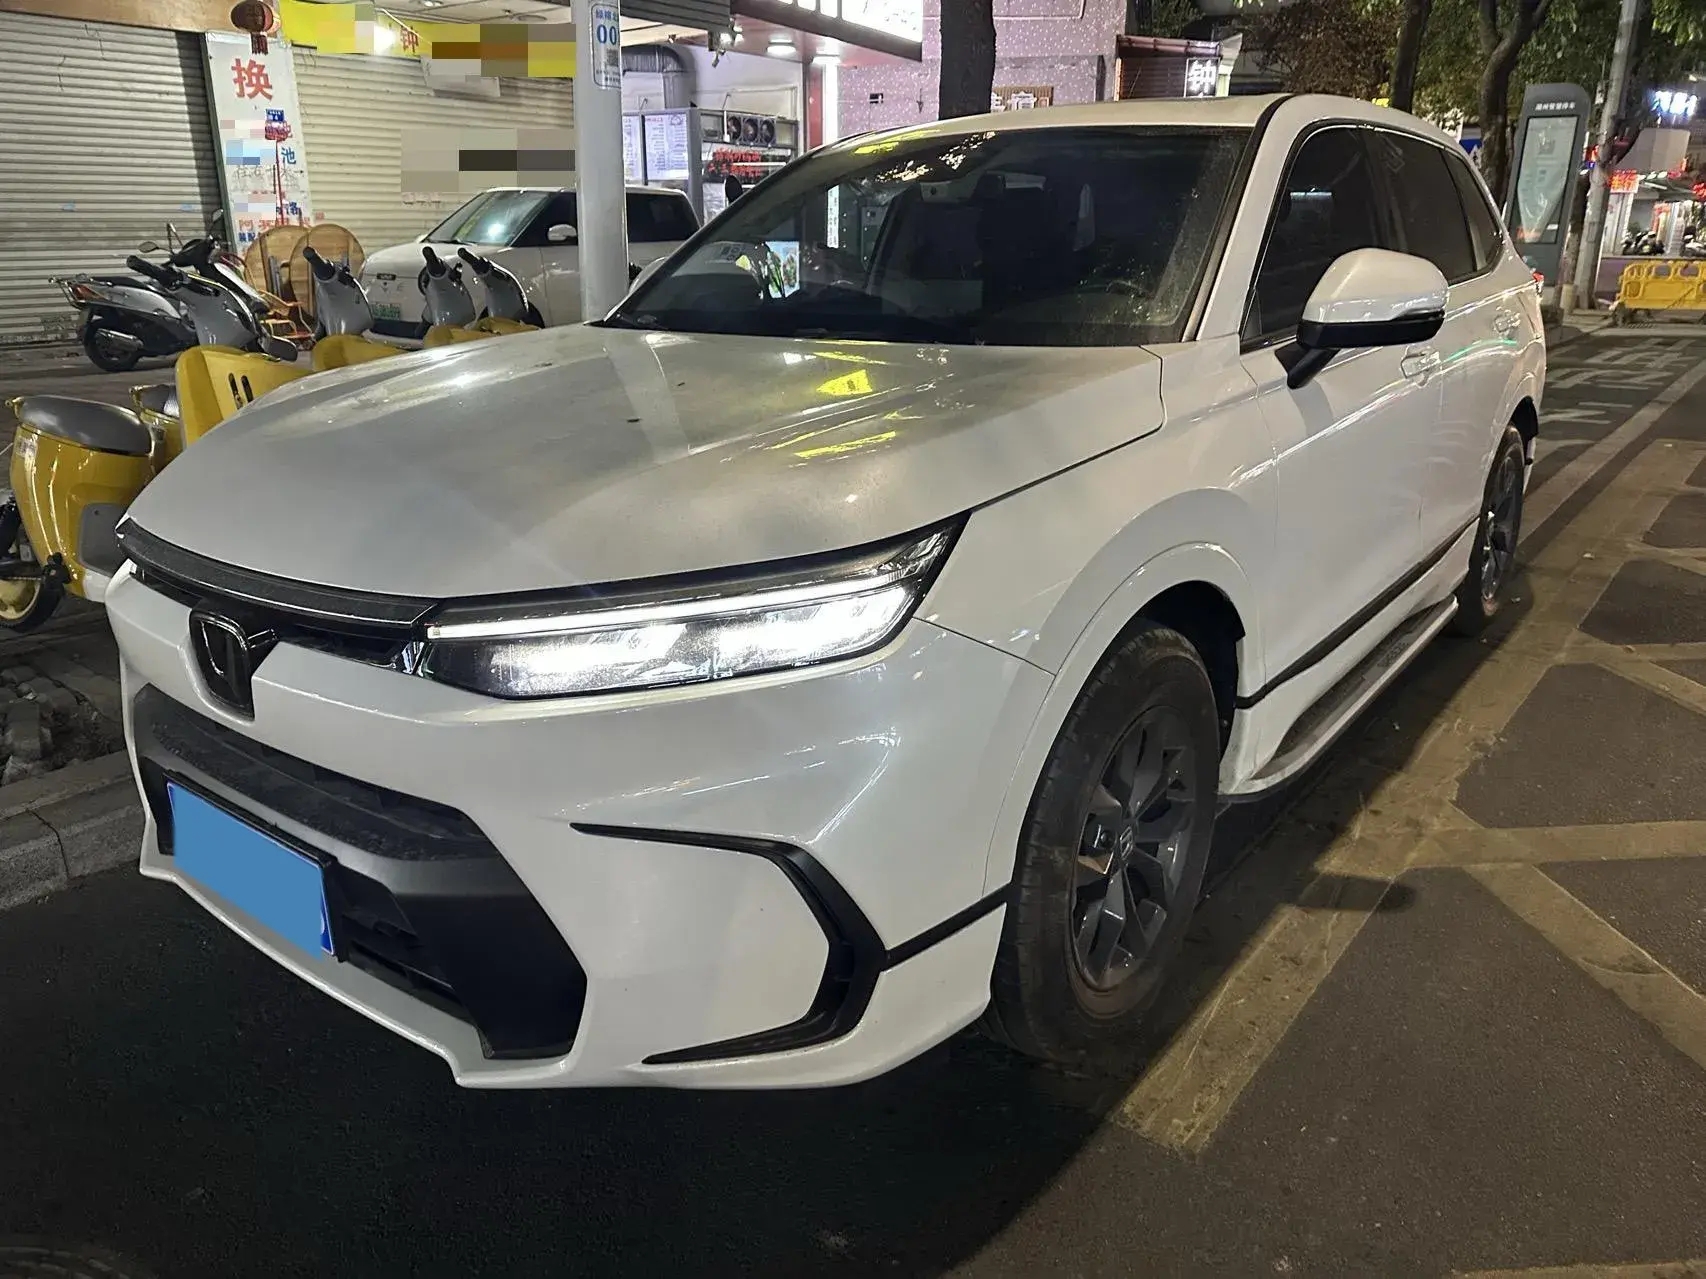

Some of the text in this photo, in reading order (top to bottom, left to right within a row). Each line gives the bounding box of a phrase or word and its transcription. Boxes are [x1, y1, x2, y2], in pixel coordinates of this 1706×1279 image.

[231, 58, 272, 100] 换
[1188, 59, 1217, 98] 钟
[281, 146, 297, 165] 池
